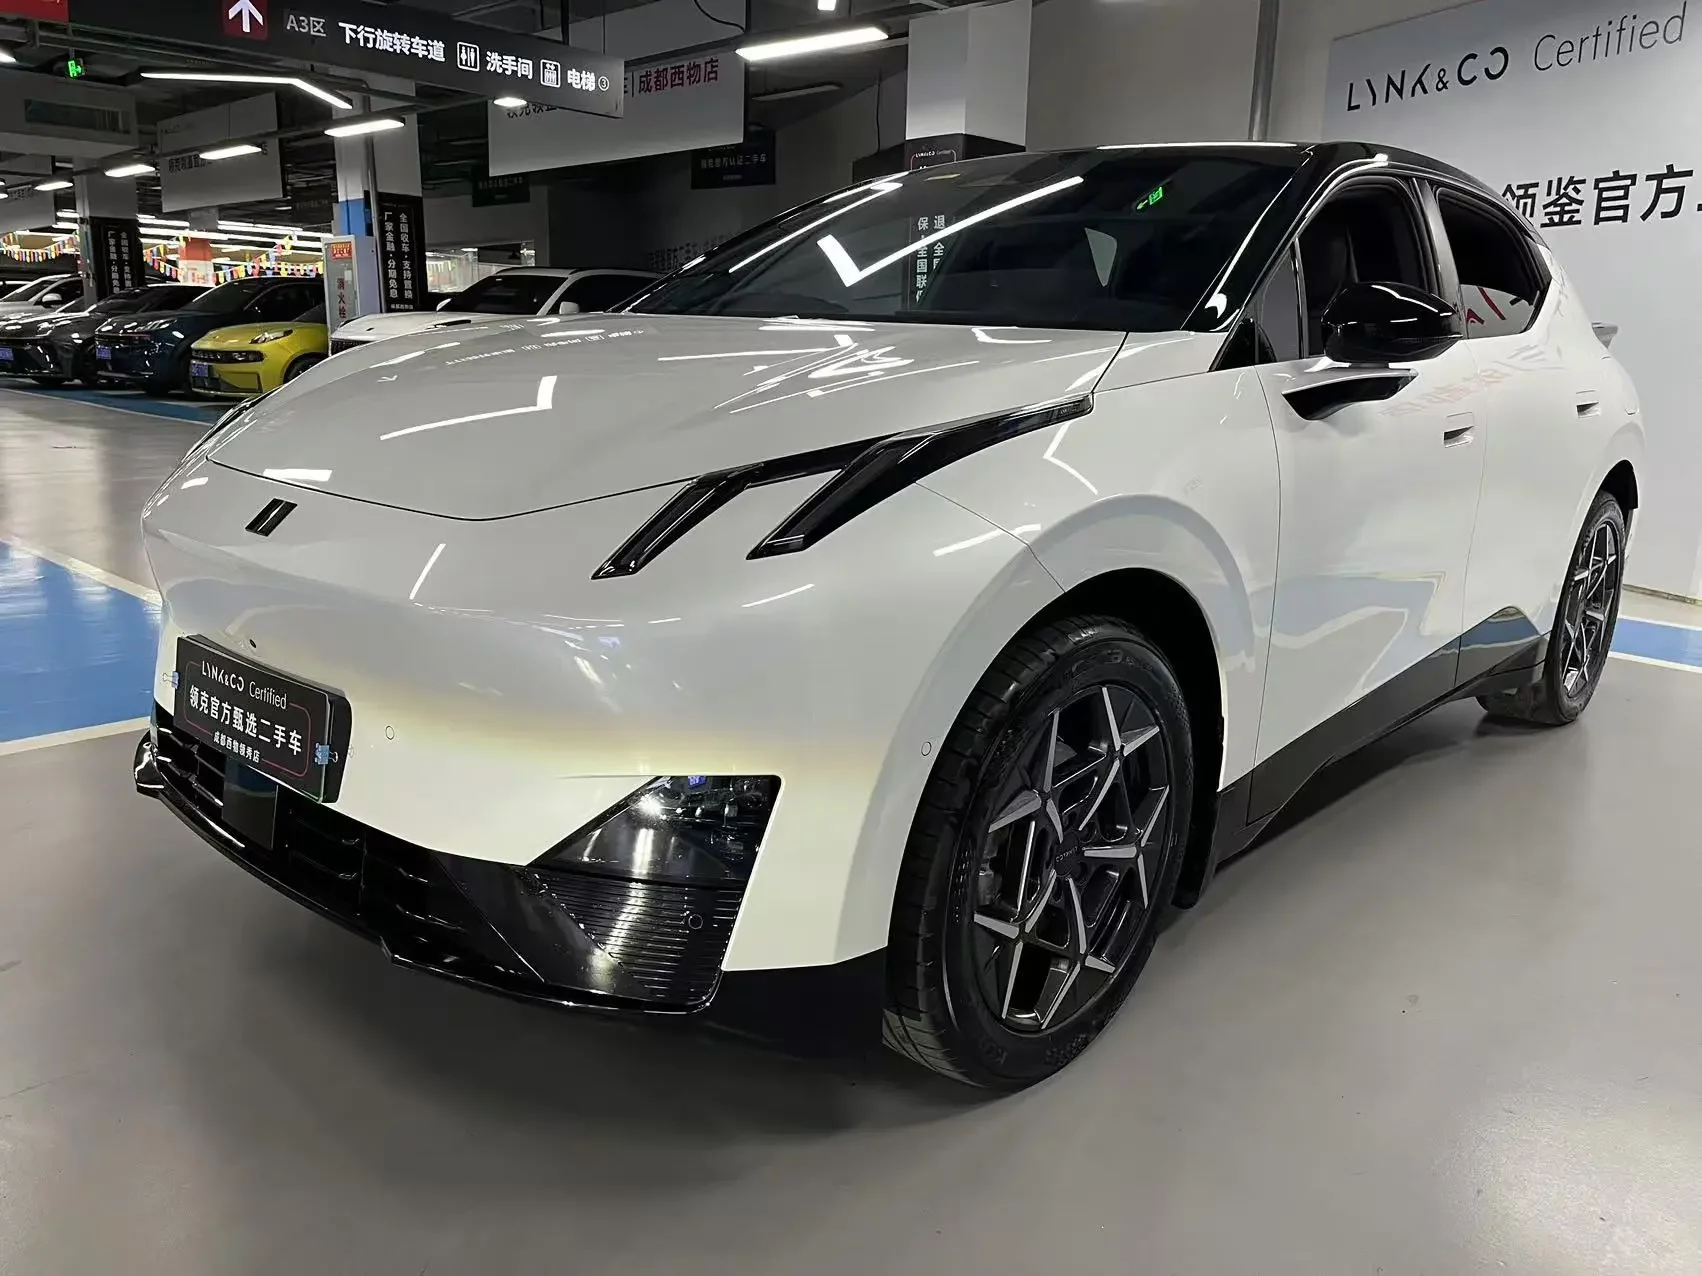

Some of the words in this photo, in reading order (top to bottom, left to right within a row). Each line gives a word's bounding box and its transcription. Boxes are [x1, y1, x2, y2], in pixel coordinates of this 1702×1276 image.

[286, 14, 327, 37] A3区
[338, 21, 446, 62] 下行旋转车道
[485, 50, 533, 80] 洗手间
[1346, 45, 1509, 111] LYNK&CO
[1533, 1, 1687, 72] Certified
[1501, 163, 1702, 229] 领鉴官方
[202, 661, 244, 692] LYNK&CO
[249, 681, 287, 709] Certified
[189, 685, 302, 755] 领克官方甄选二手车
